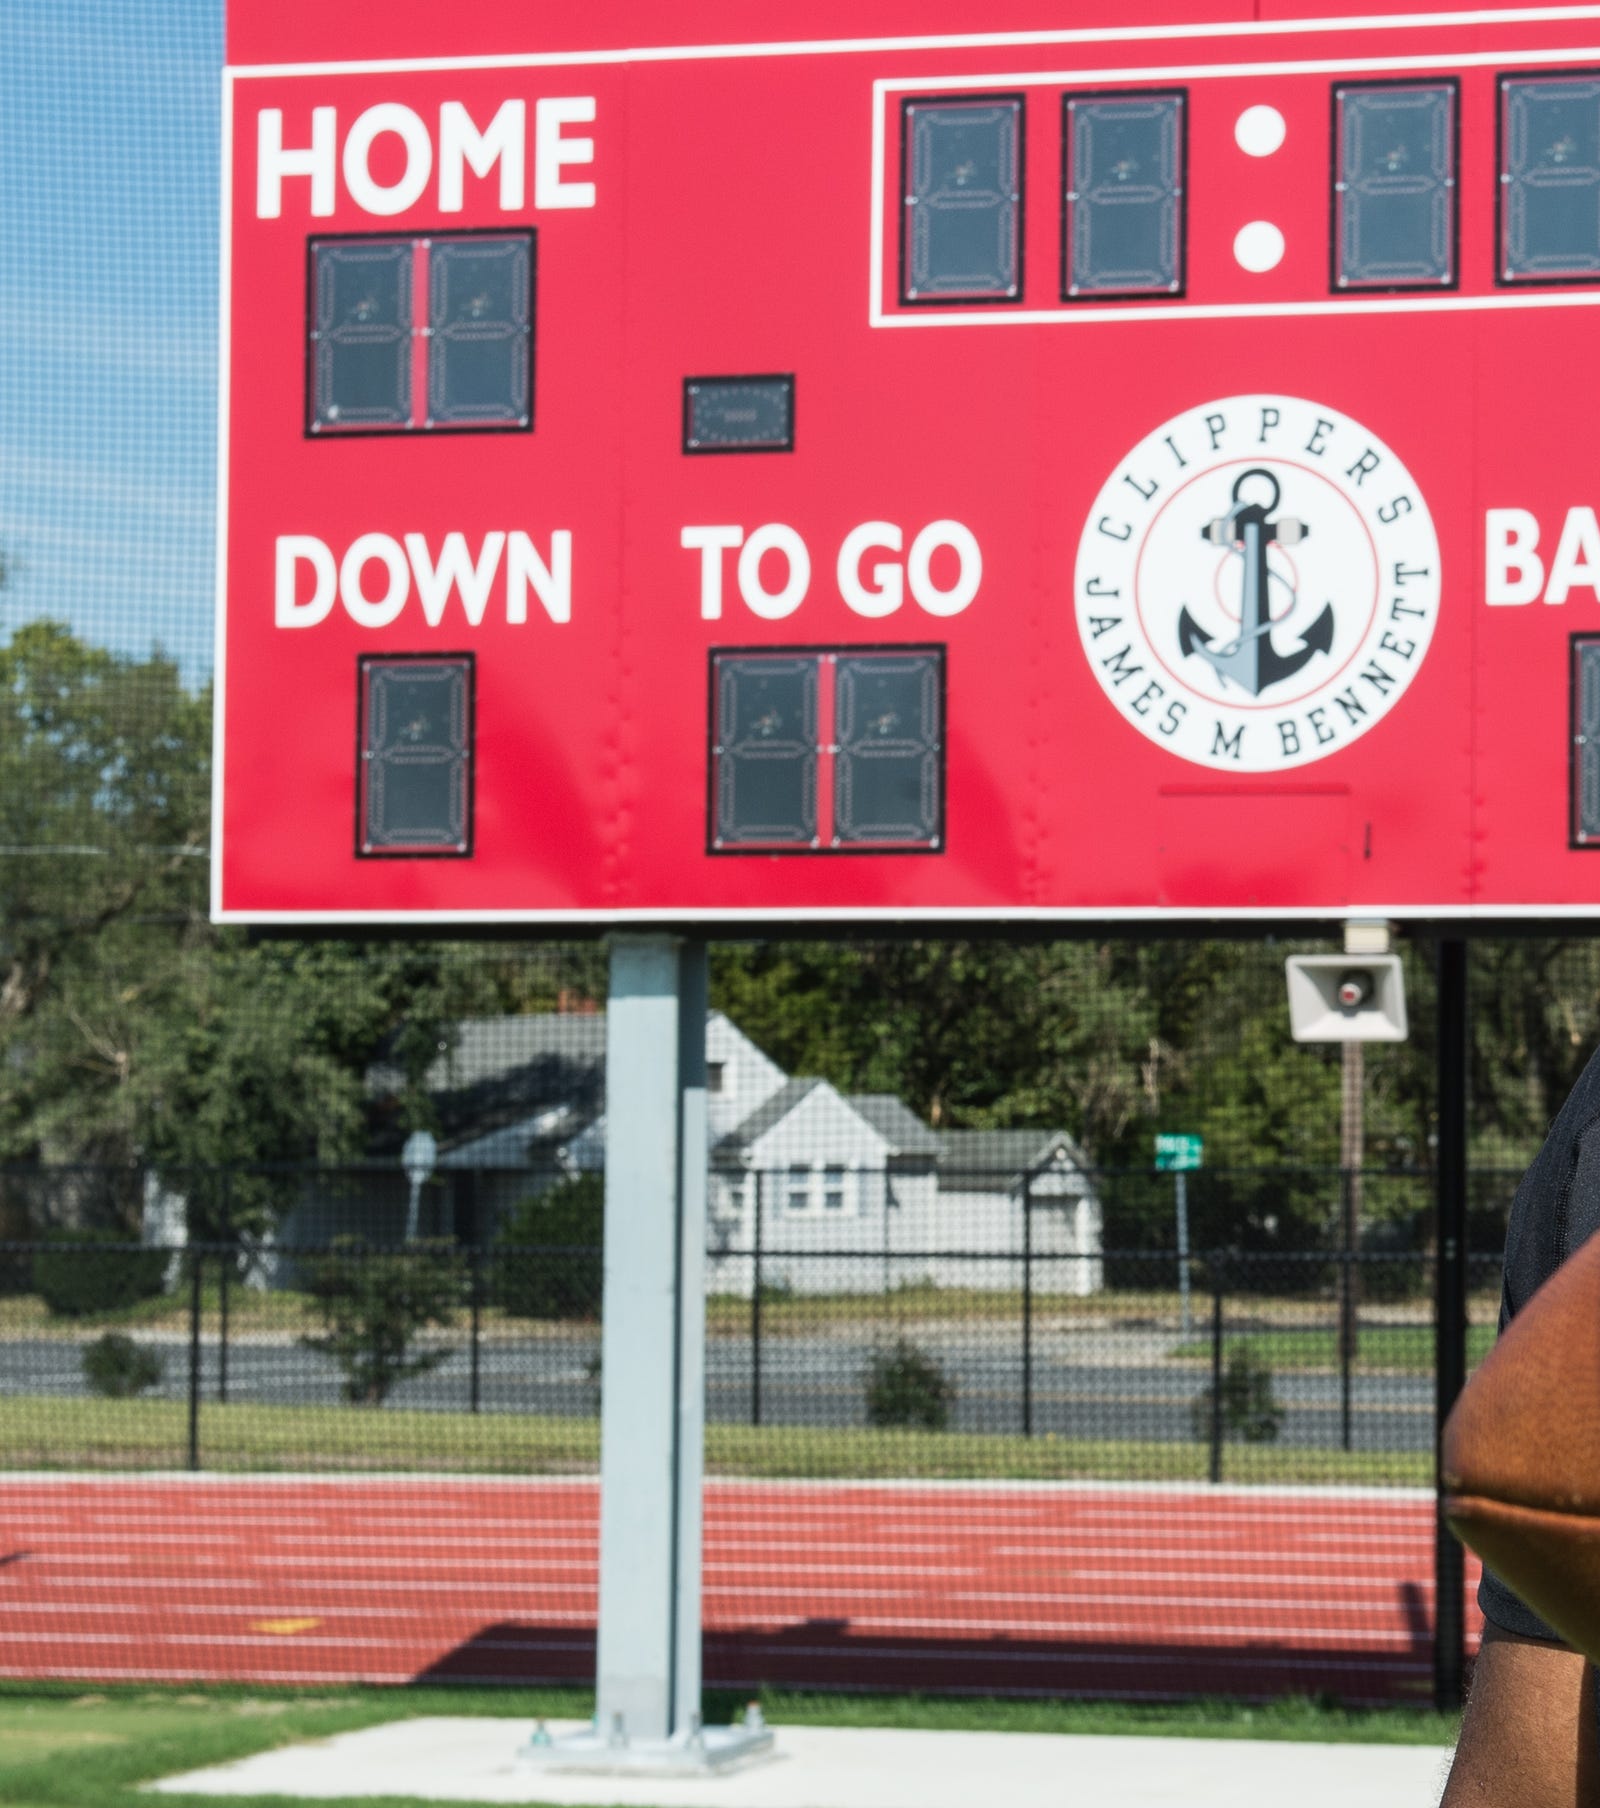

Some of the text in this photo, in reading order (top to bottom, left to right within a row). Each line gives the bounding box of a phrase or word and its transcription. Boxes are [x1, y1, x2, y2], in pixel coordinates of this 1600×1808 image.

[256, 96, 597, 219] HOME
[1098, 407, 1413, 542] CLIPPERS
[274, 529, 573, 629] DOWN
[681, 519, 983, 620] TO GO
[1086, 562, 1430, 760] JAMES M BENNETT
